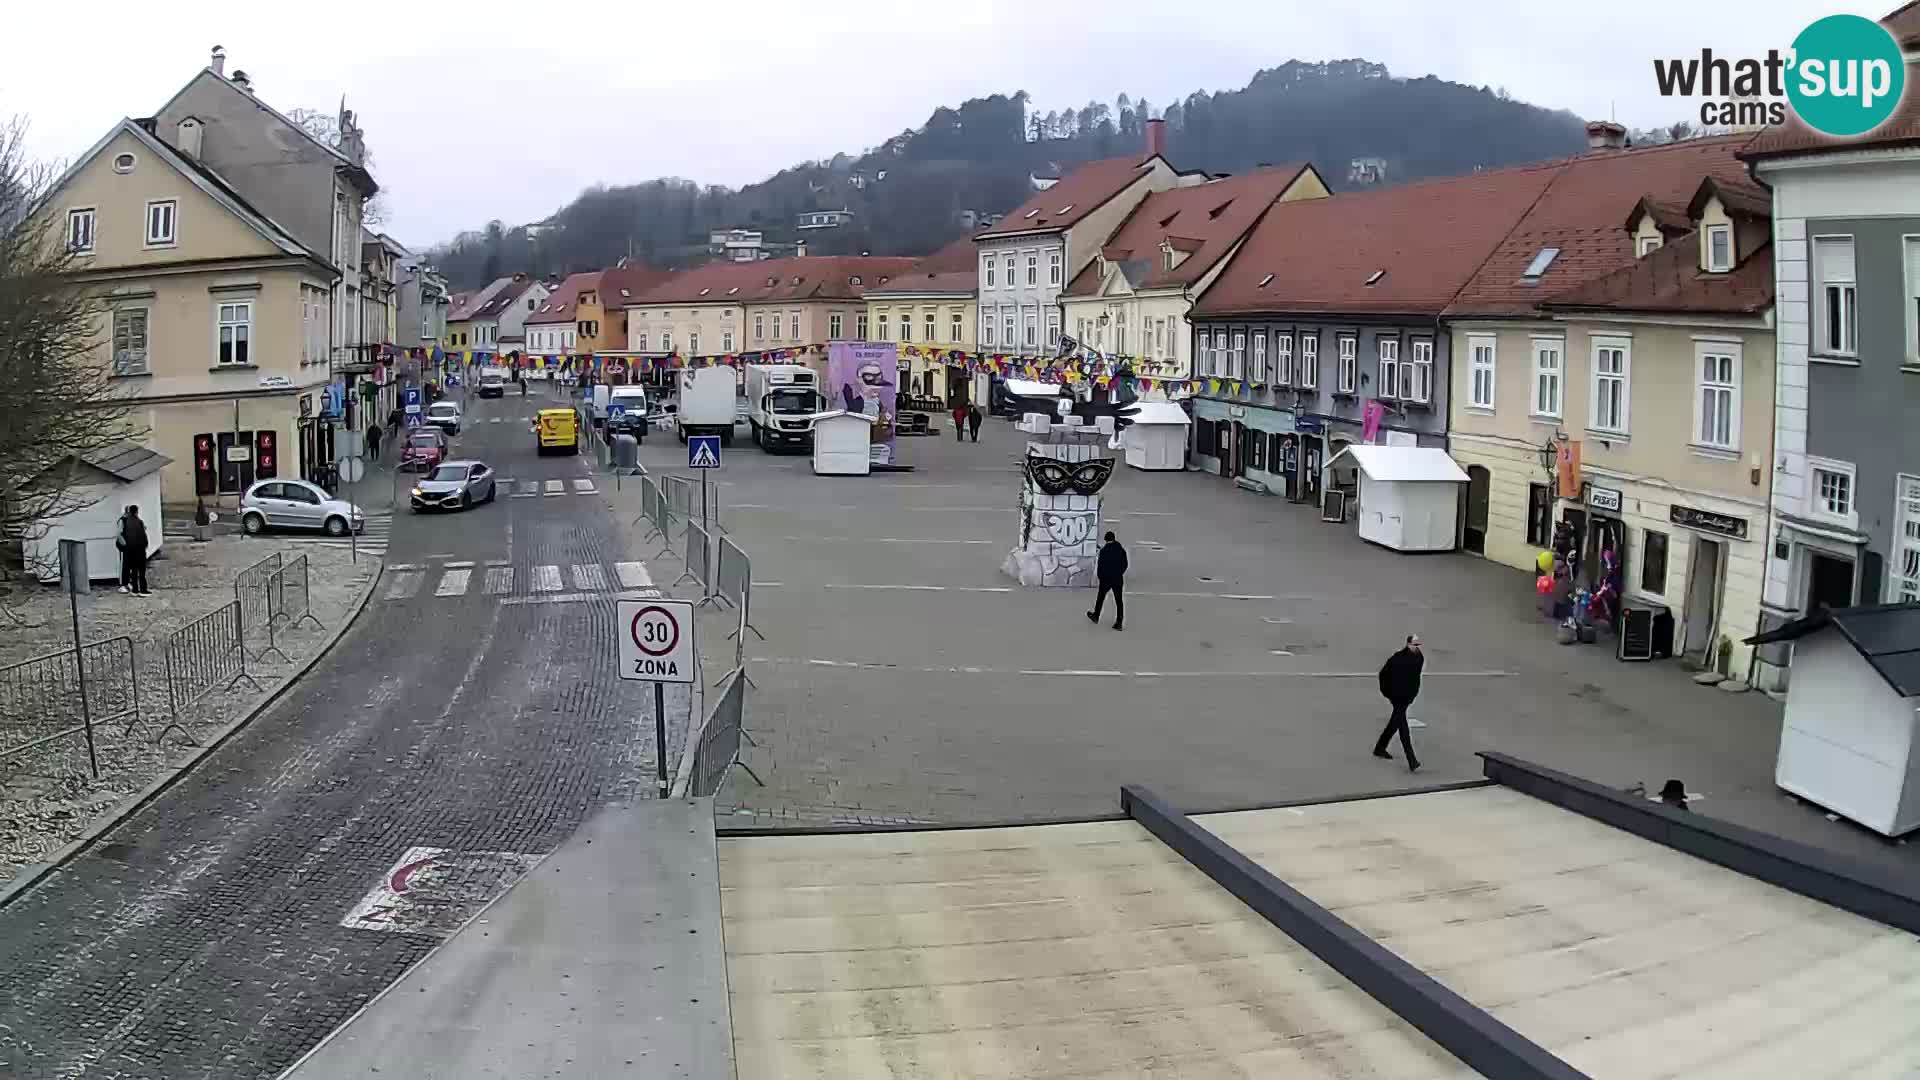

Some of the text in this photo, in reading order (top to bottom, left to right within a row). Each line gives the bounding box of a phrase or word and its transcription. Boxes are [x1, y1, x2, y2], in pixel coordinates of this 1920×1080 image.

[409, 391, 417, 402] P
[1048, 515, 1087, 545] 200
[644, 621, 667, 642] 30
[634, 659, 678, 676] ZONA
